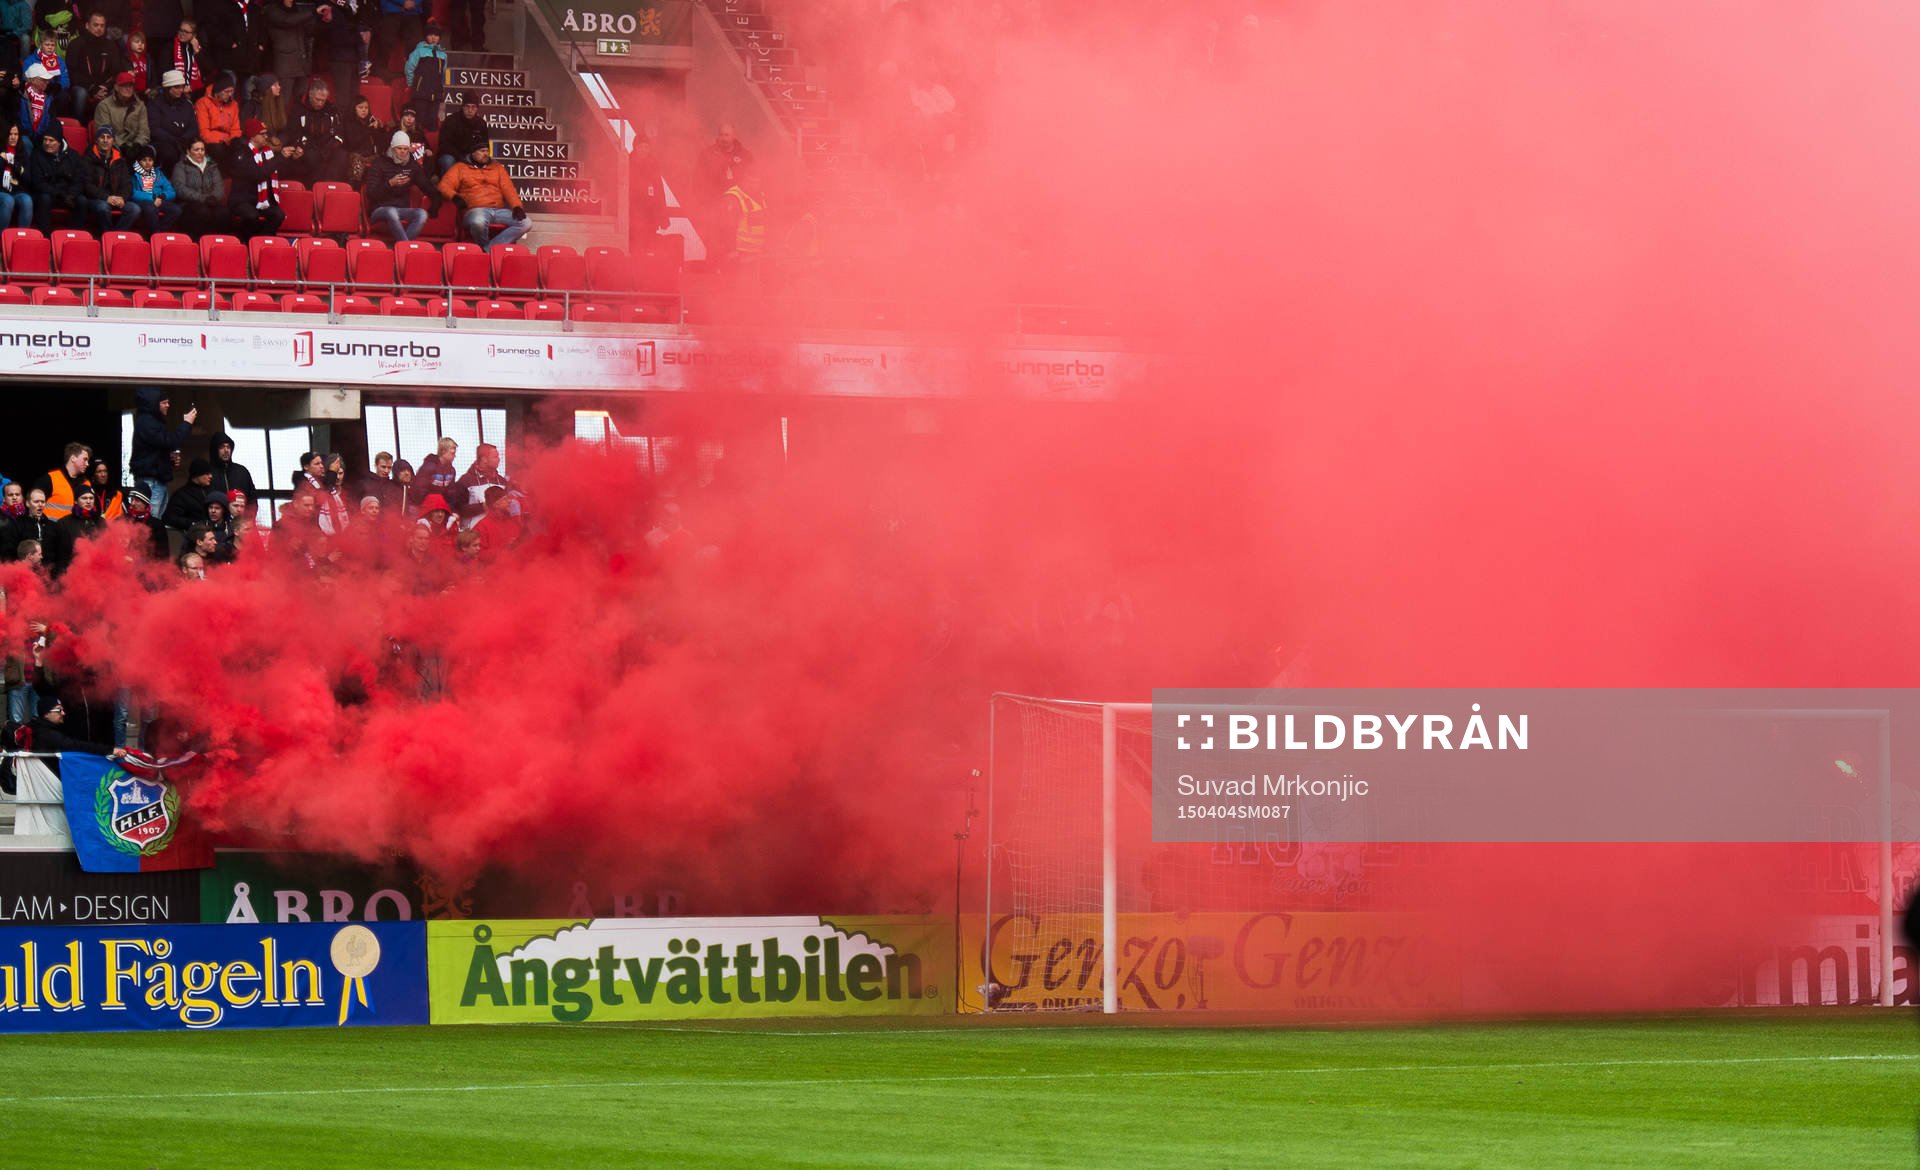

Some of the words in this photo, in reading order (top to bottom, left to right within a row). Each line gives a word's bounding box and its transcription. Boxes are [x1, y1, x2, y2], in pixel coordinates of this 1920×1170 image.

[560, 8, 637, 34] ÅBRO
[459, 71, 522, 87] SVENSK
[502, 143, 566, 159] SVENSK
[148, 337, 193, 345] sunnerbo
[320, 341, 441, 358] sunnerbo
[992, 360, 1105, 377] sunnerbo
[120, 806, 159, 831] H.I.F.
[138, 827, 160, 835] 1907
[0, 895, 54, 920] LAM
[74, 895, 169, 920] DESIGN
[225, 881, 412, 924] ÅBRO
[99, 936, 325, 1029] Fågeln
[460, 924, 923, 1022] Ångtvättbilen
